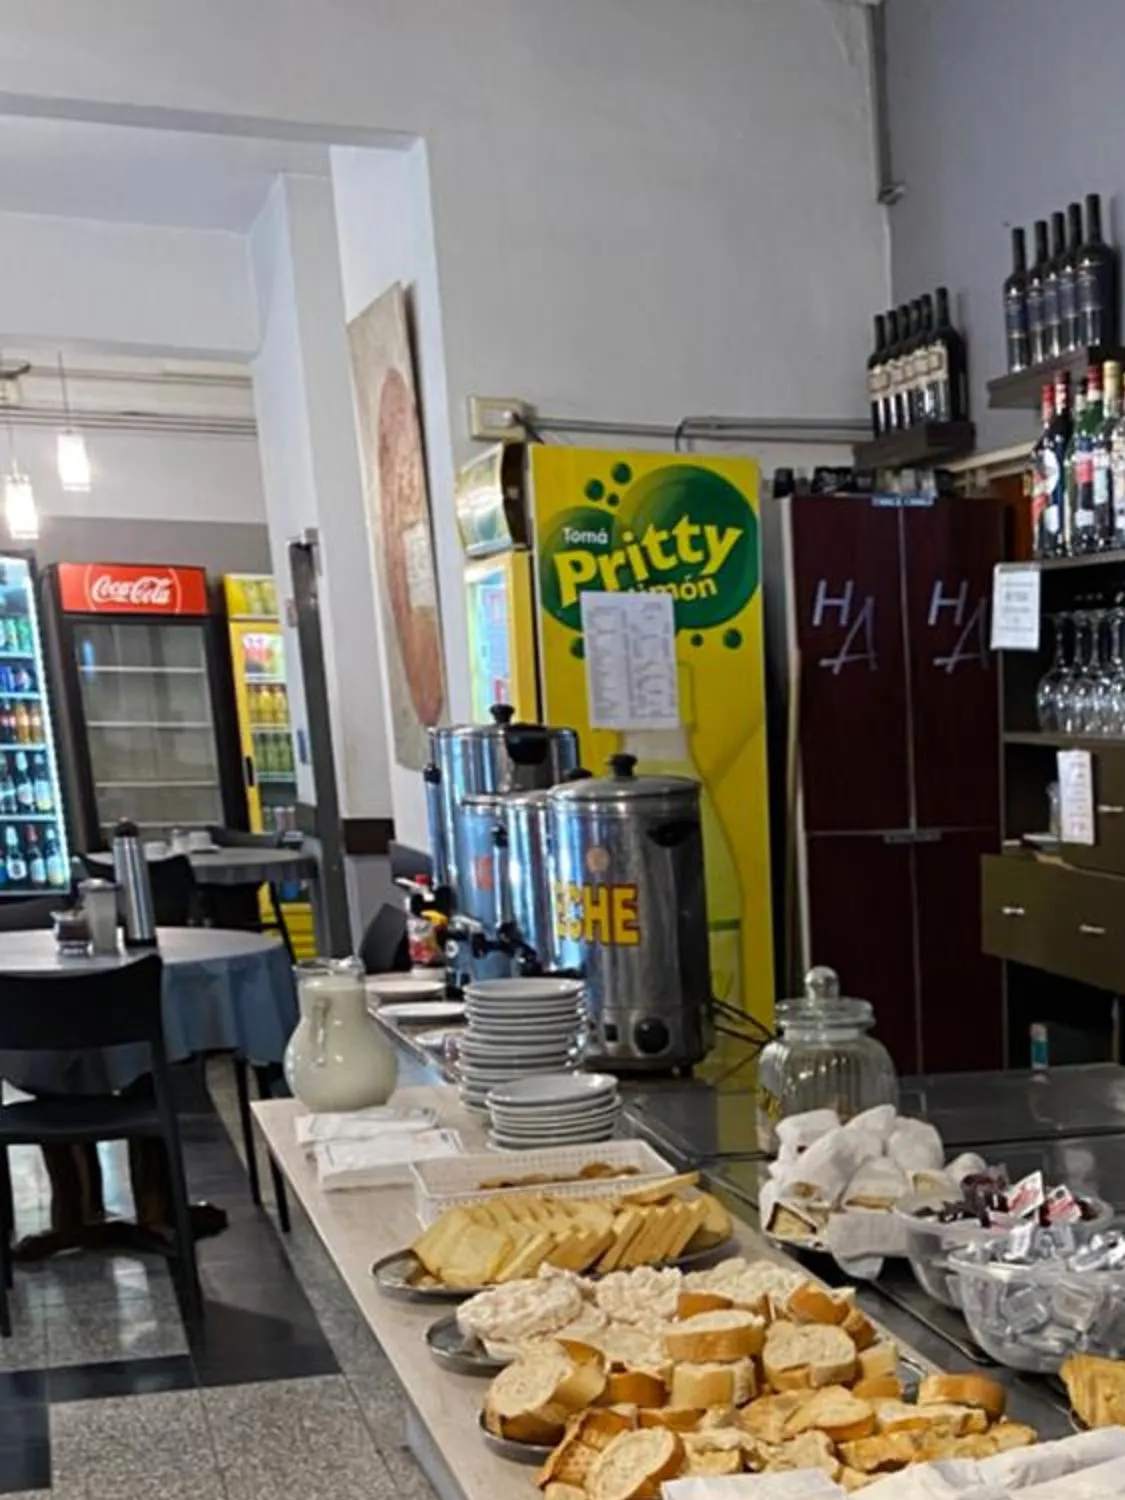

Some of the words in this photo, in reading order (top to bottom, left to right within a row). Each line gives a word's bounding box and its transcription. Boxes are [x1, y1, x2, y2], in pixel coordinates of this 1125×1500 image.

[563, 527, 608, 545] Tomá
[553, 514, 744, 608] Pritty
[628, 573, 718, 601] món
[554, 882, 641, 947] ECHE
